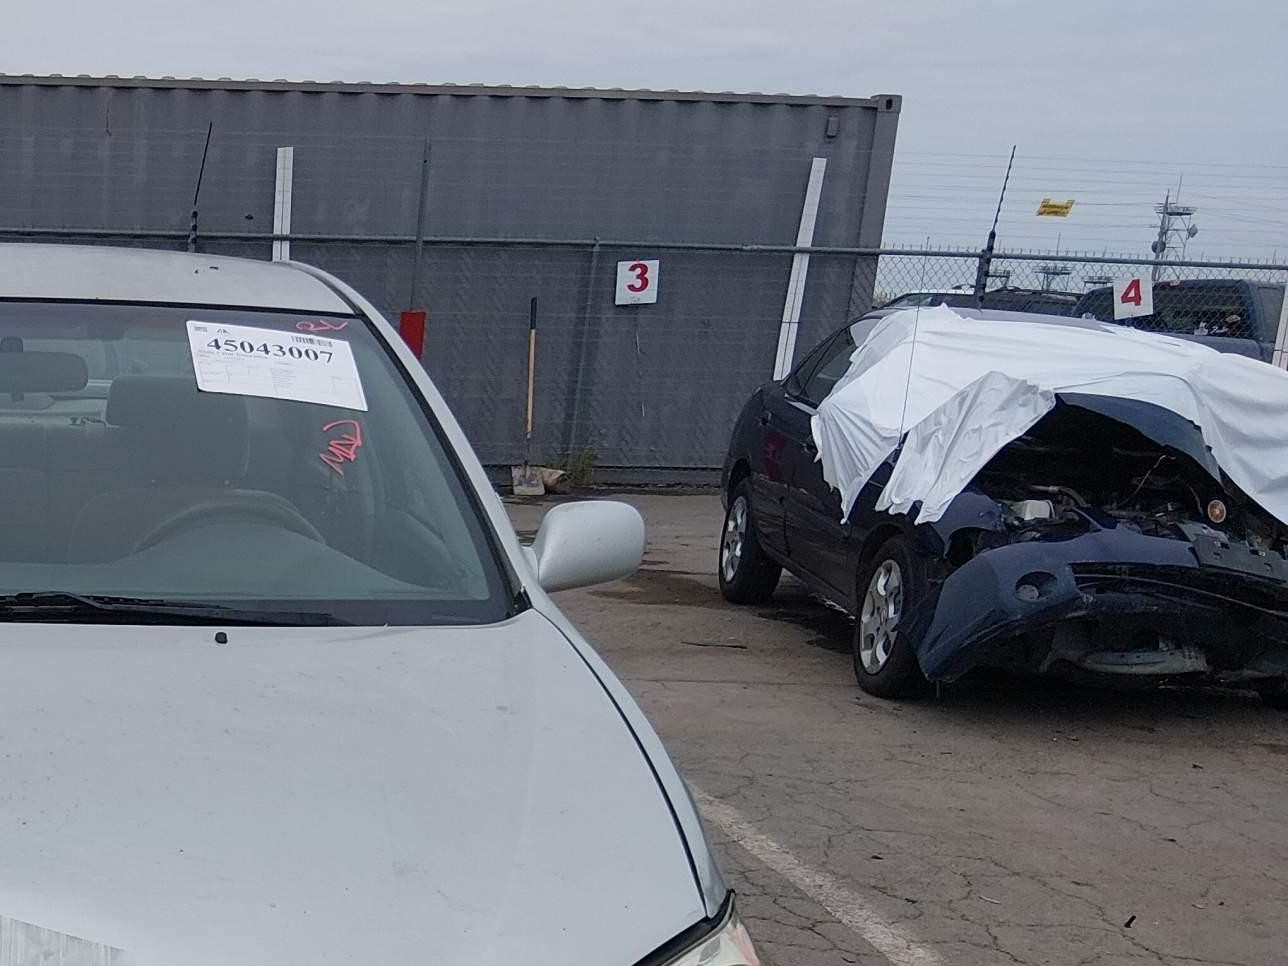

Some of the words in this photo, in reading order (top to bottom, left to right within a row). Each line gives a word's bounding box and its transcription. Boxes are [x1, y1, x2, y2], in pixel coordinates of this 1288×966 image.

[627, 263, 649, 292] 3
[1120, 278, 1142, 306] 4
[206, 338, 333, 364] 45043007
